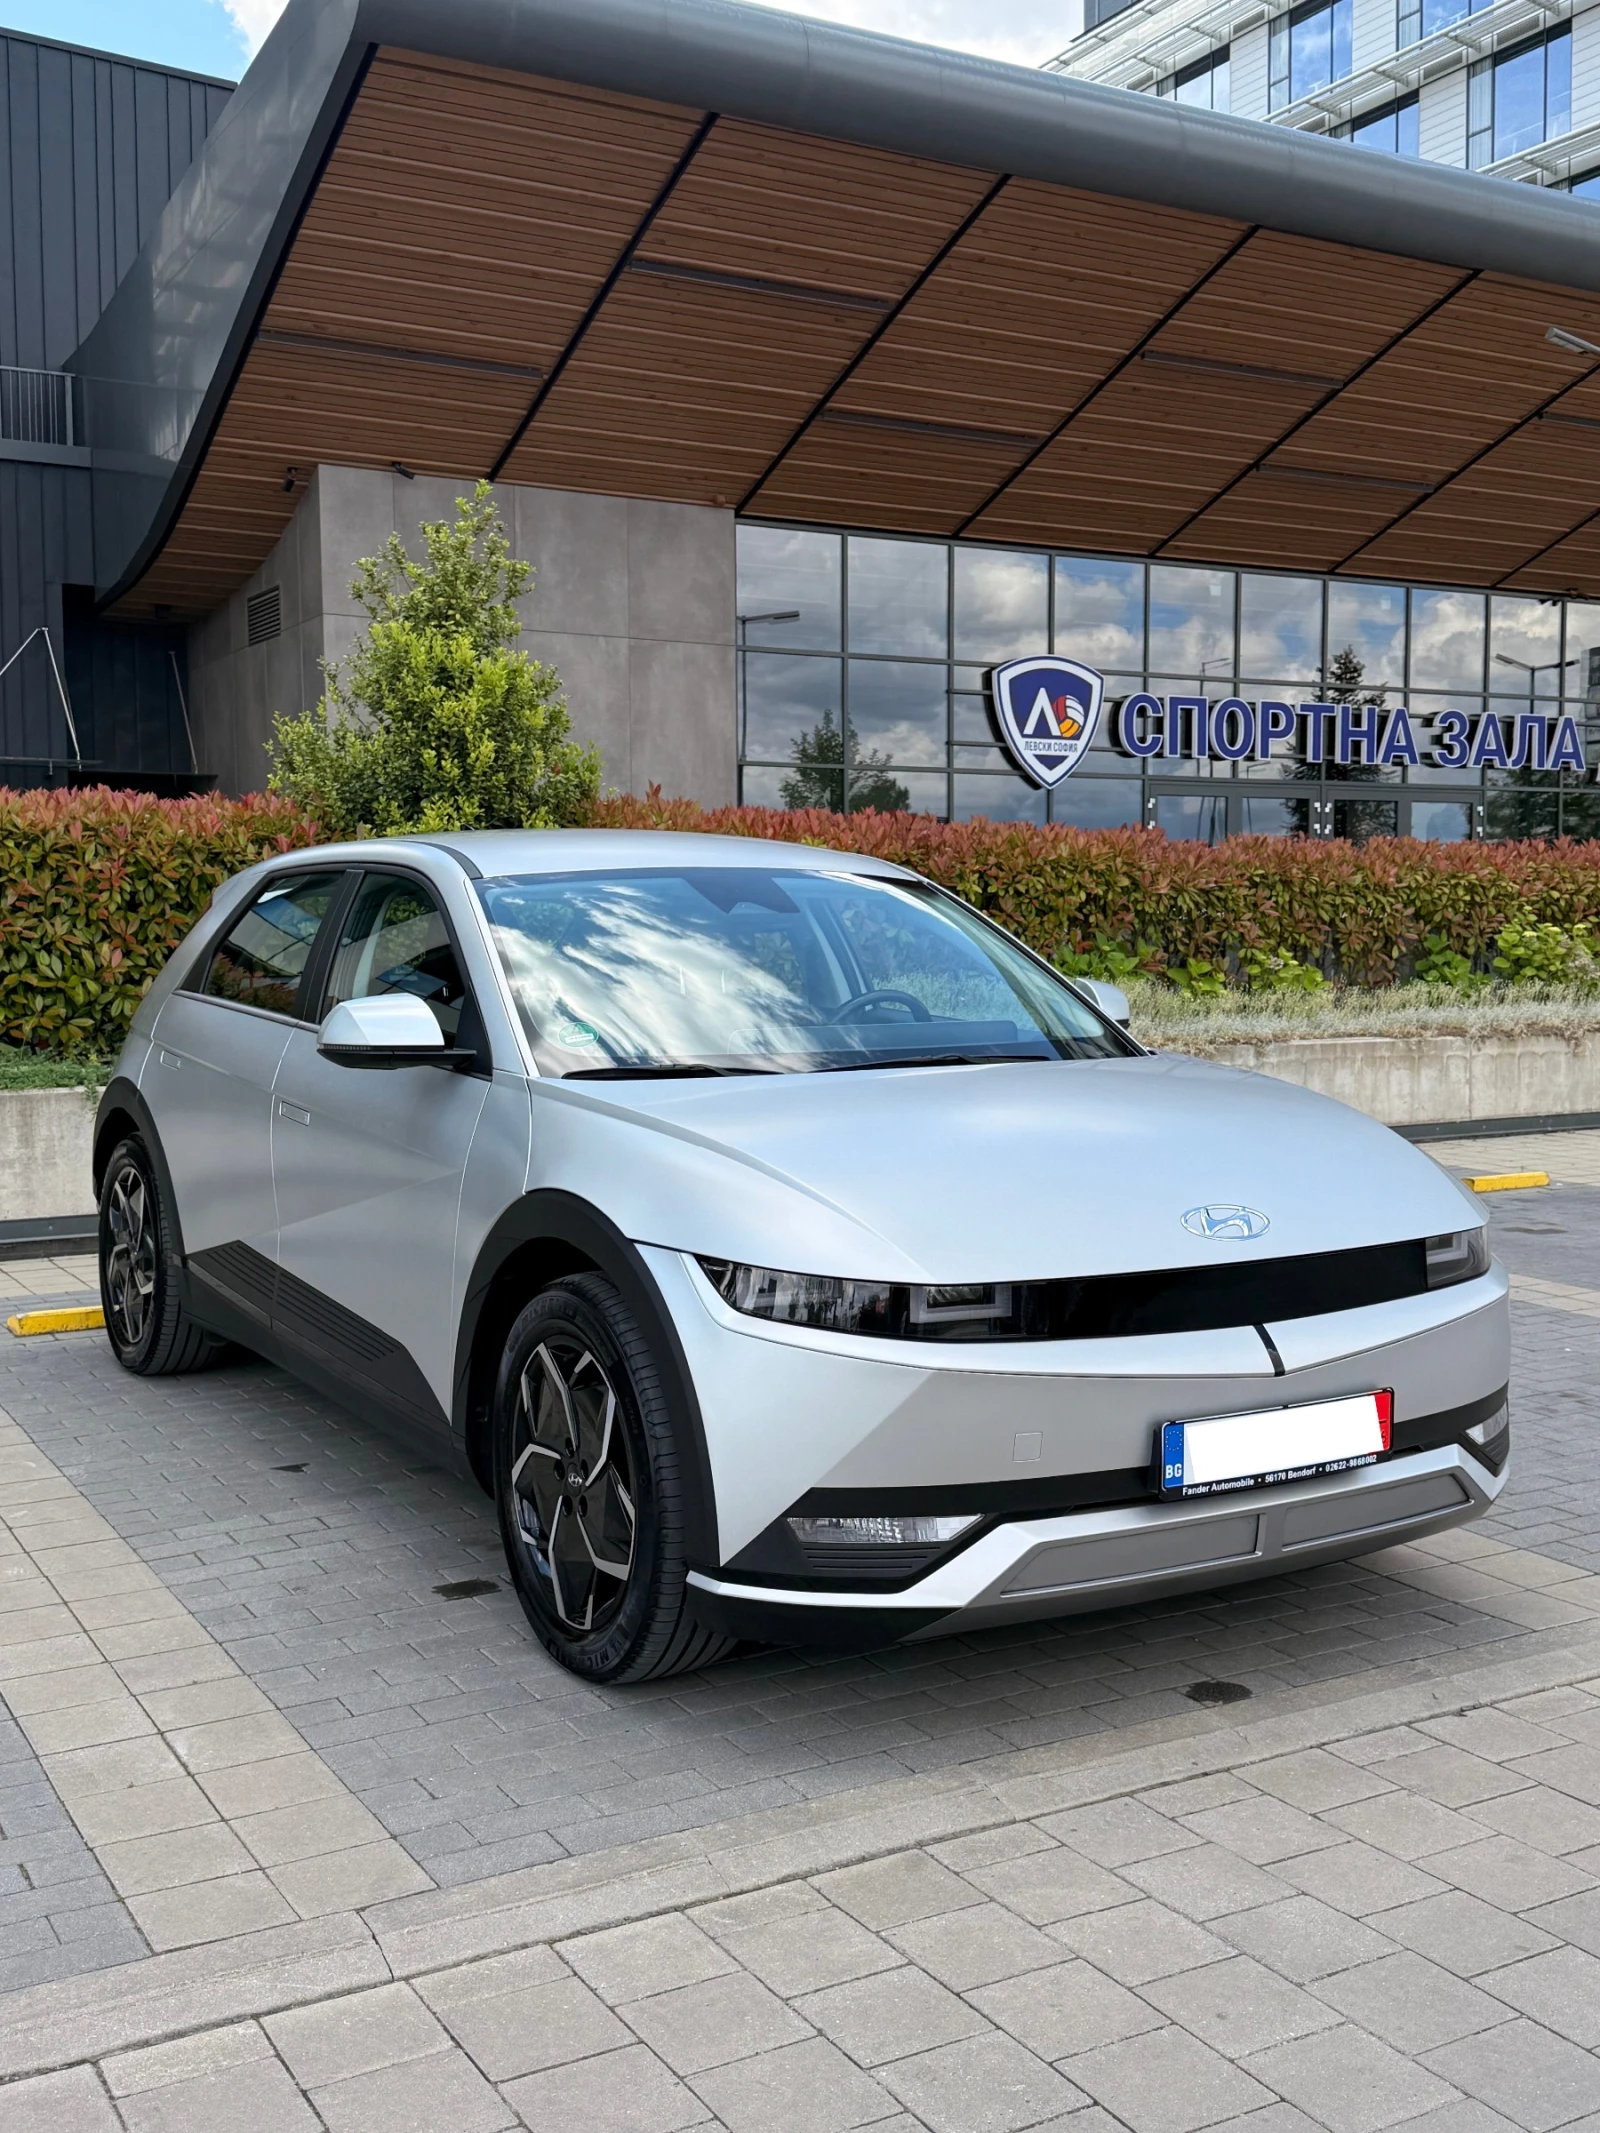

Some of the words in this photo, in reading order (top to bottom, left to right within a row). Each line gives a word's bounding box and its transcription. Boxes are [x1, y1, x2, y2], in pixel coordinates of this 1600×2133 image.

[1118, 692, 1420, 766] СПОРТНА
[1432, 708, 1586, 772] ЗАЛА
[1024, 740, 1052, 752] ЛЕВСКИ
[1053, 742, 1078, 753] СОФИЯ
[1165, 1463, 1182, 1479] BG
[1182, 1484, 1210, 1496] Fander
[1211, 1478, 1254, 1492] Automobile
[1264, 1472, 1286, 1484] 56170
[1287, 1466, 1317, 1479] Bendorf
